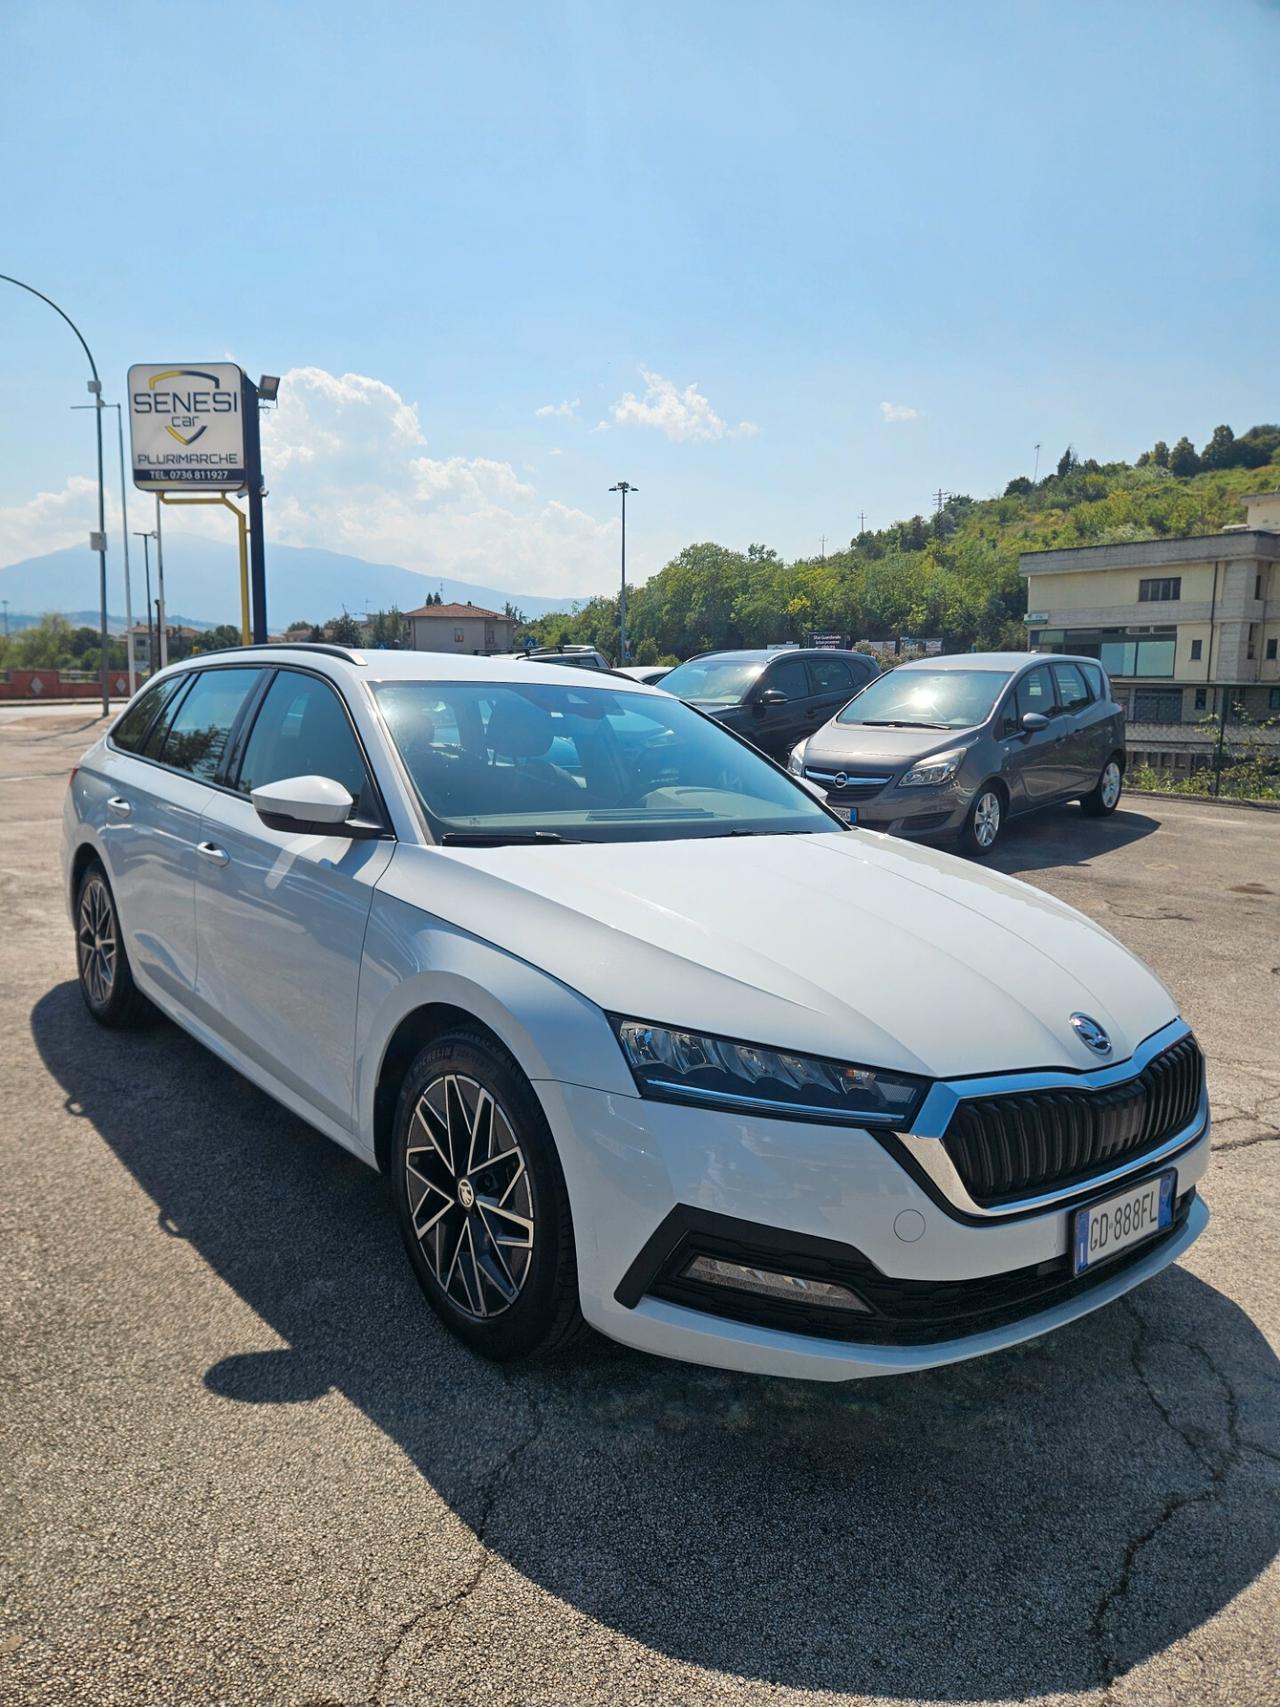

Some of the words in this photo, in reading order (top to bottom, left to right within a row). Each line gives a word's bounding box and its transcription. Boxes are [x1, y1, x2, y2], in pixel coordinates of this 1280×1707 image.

[133, 392, 237, 413] SENESI
[171, 416, 199, 427] car
[137, 453, 238, 465] PLURIMARCHE
[150, 471, 168, 480] TEL.
[170, 471, 192, 480] 0736
[194, 470, 228, 480] 811927
